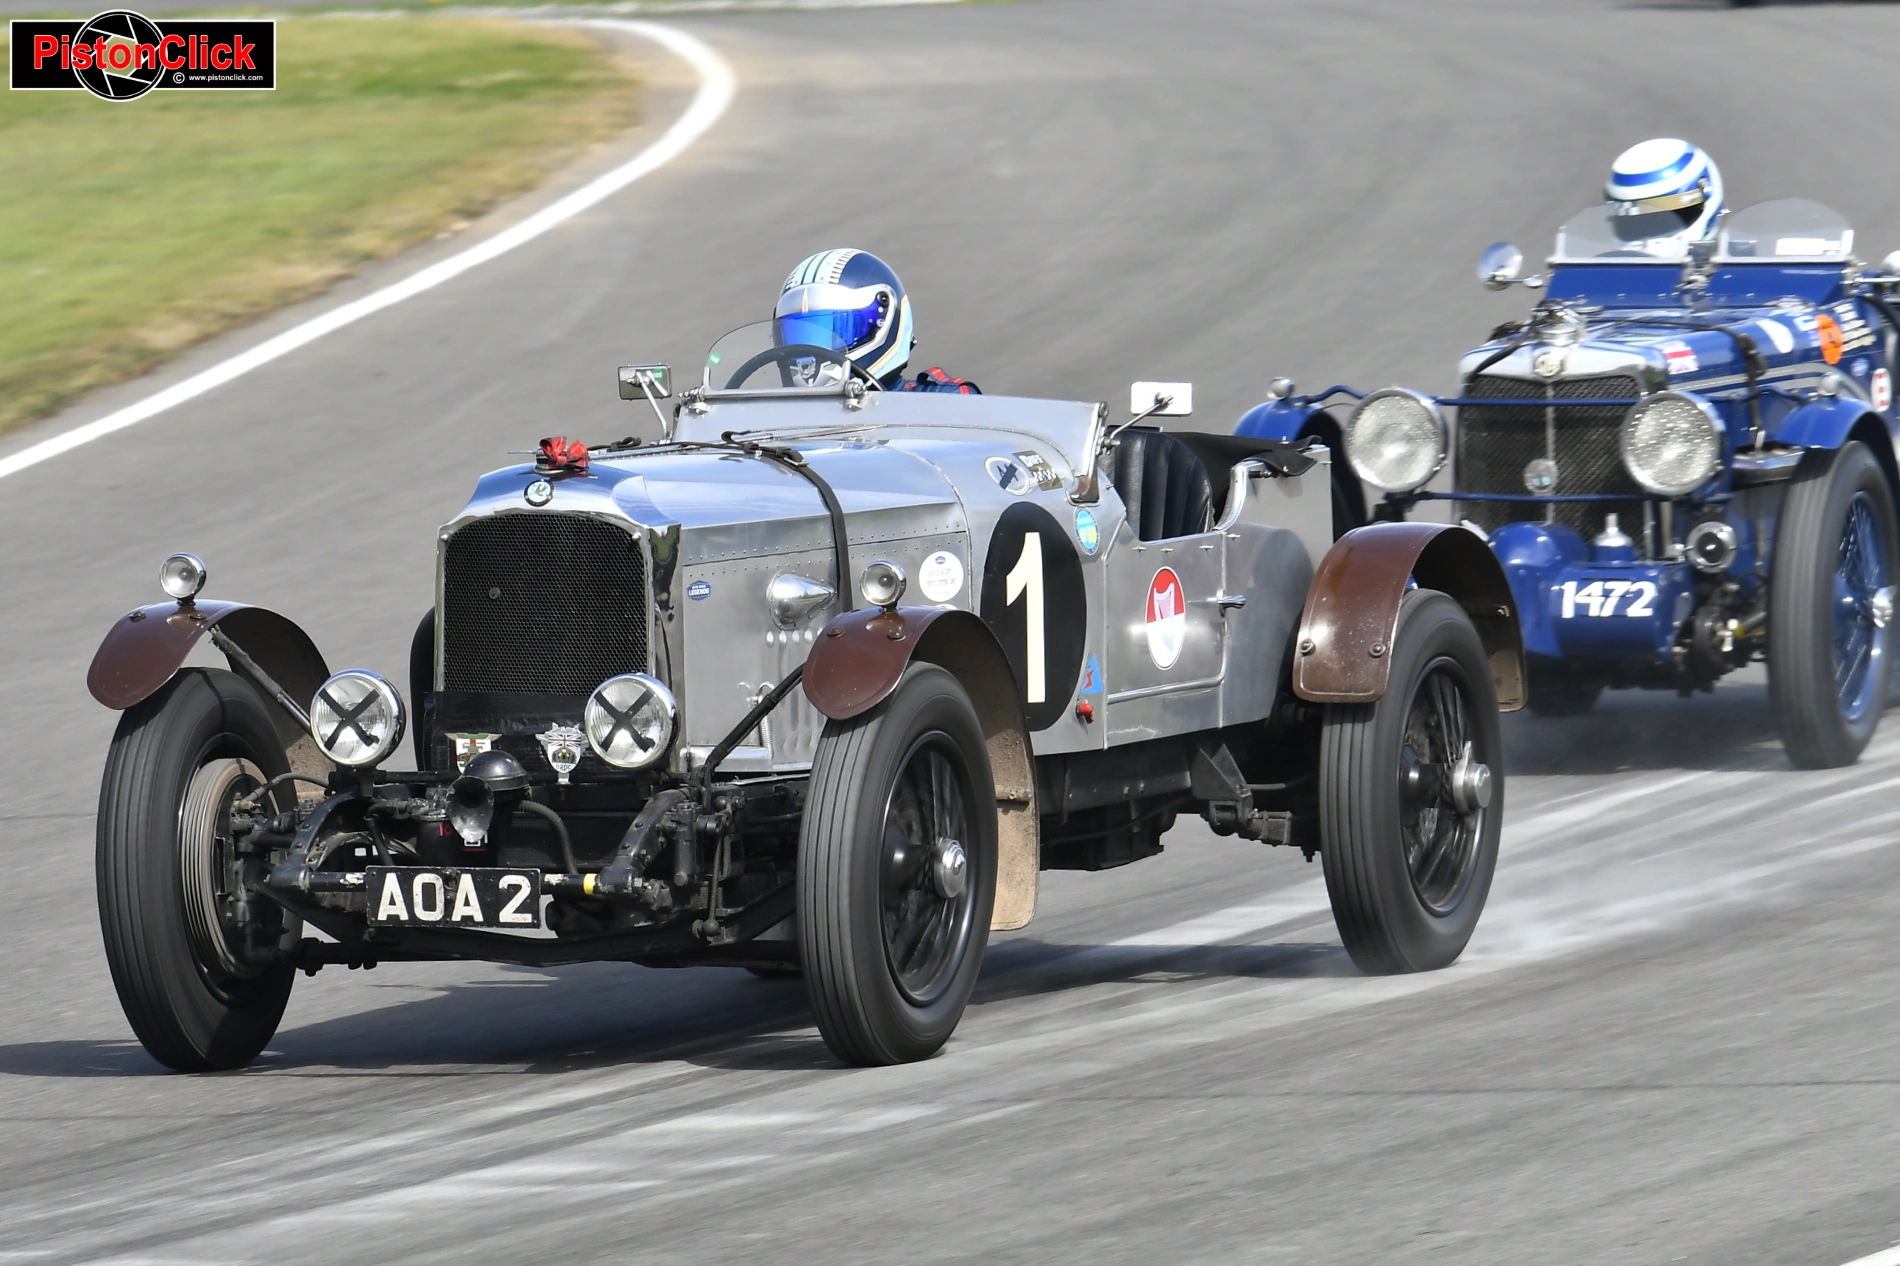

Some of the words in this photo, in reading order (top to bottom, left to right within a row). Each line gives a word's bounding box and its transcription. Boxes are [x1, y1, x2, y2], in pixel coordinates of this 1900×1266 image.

[1006, 532, 1046, 703] 1
[1560, 581, 1657, 618] 1472
[377, 872, 484, 922] AOA
[498, 874, 533, 923] 2
